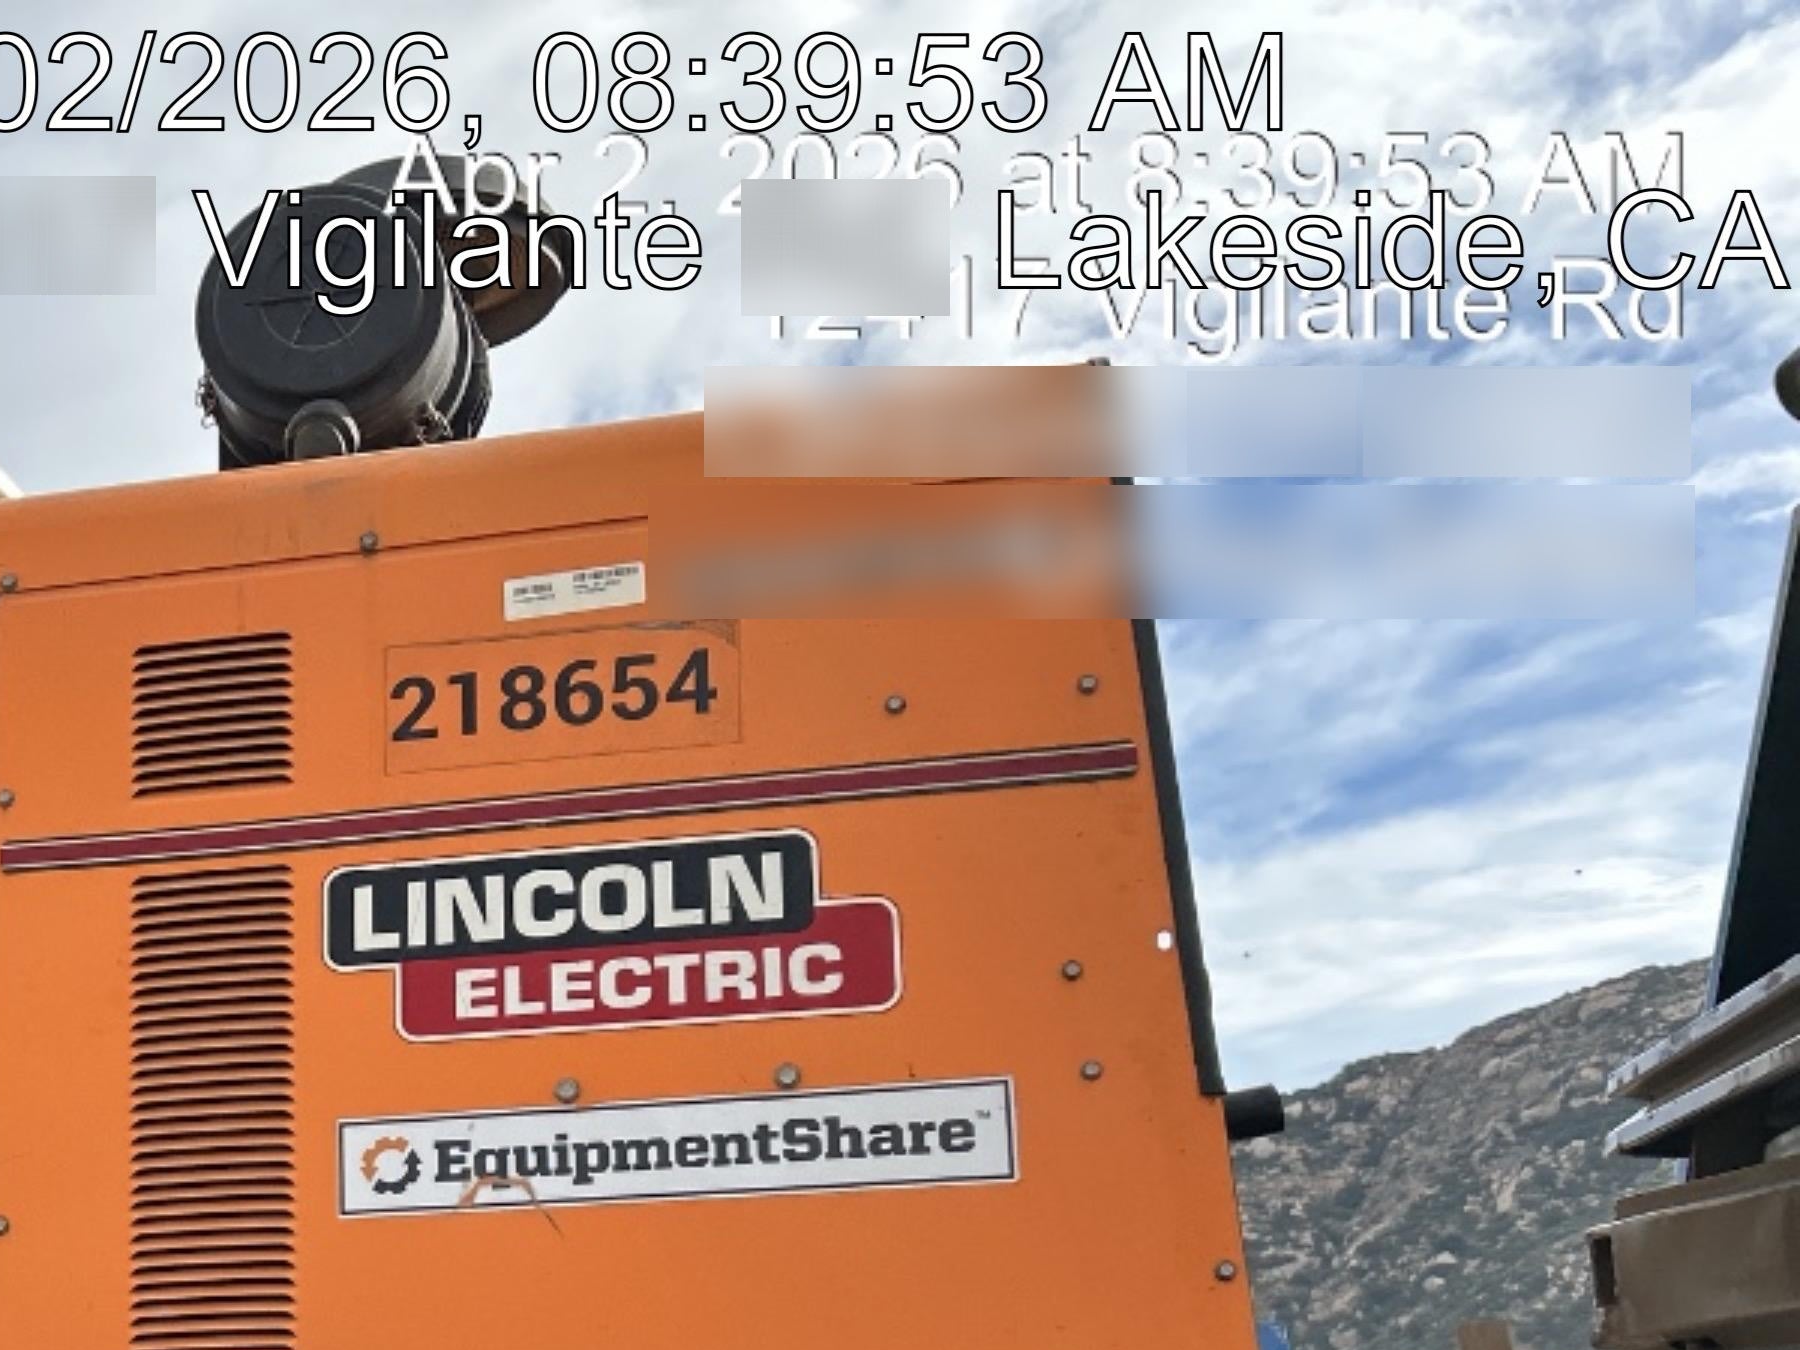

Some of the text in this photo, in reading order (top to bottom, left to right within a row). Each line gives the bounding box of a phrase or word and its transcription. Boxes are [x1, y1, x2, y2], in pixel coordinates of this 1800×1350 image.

[389, 648, 717, 743] 218654
[352, 850, 786, 953] LINCOLN
[453, 942, 844, 1020] ELECTRIC
[433, 1117, 977, 1191] EquipmentShare
